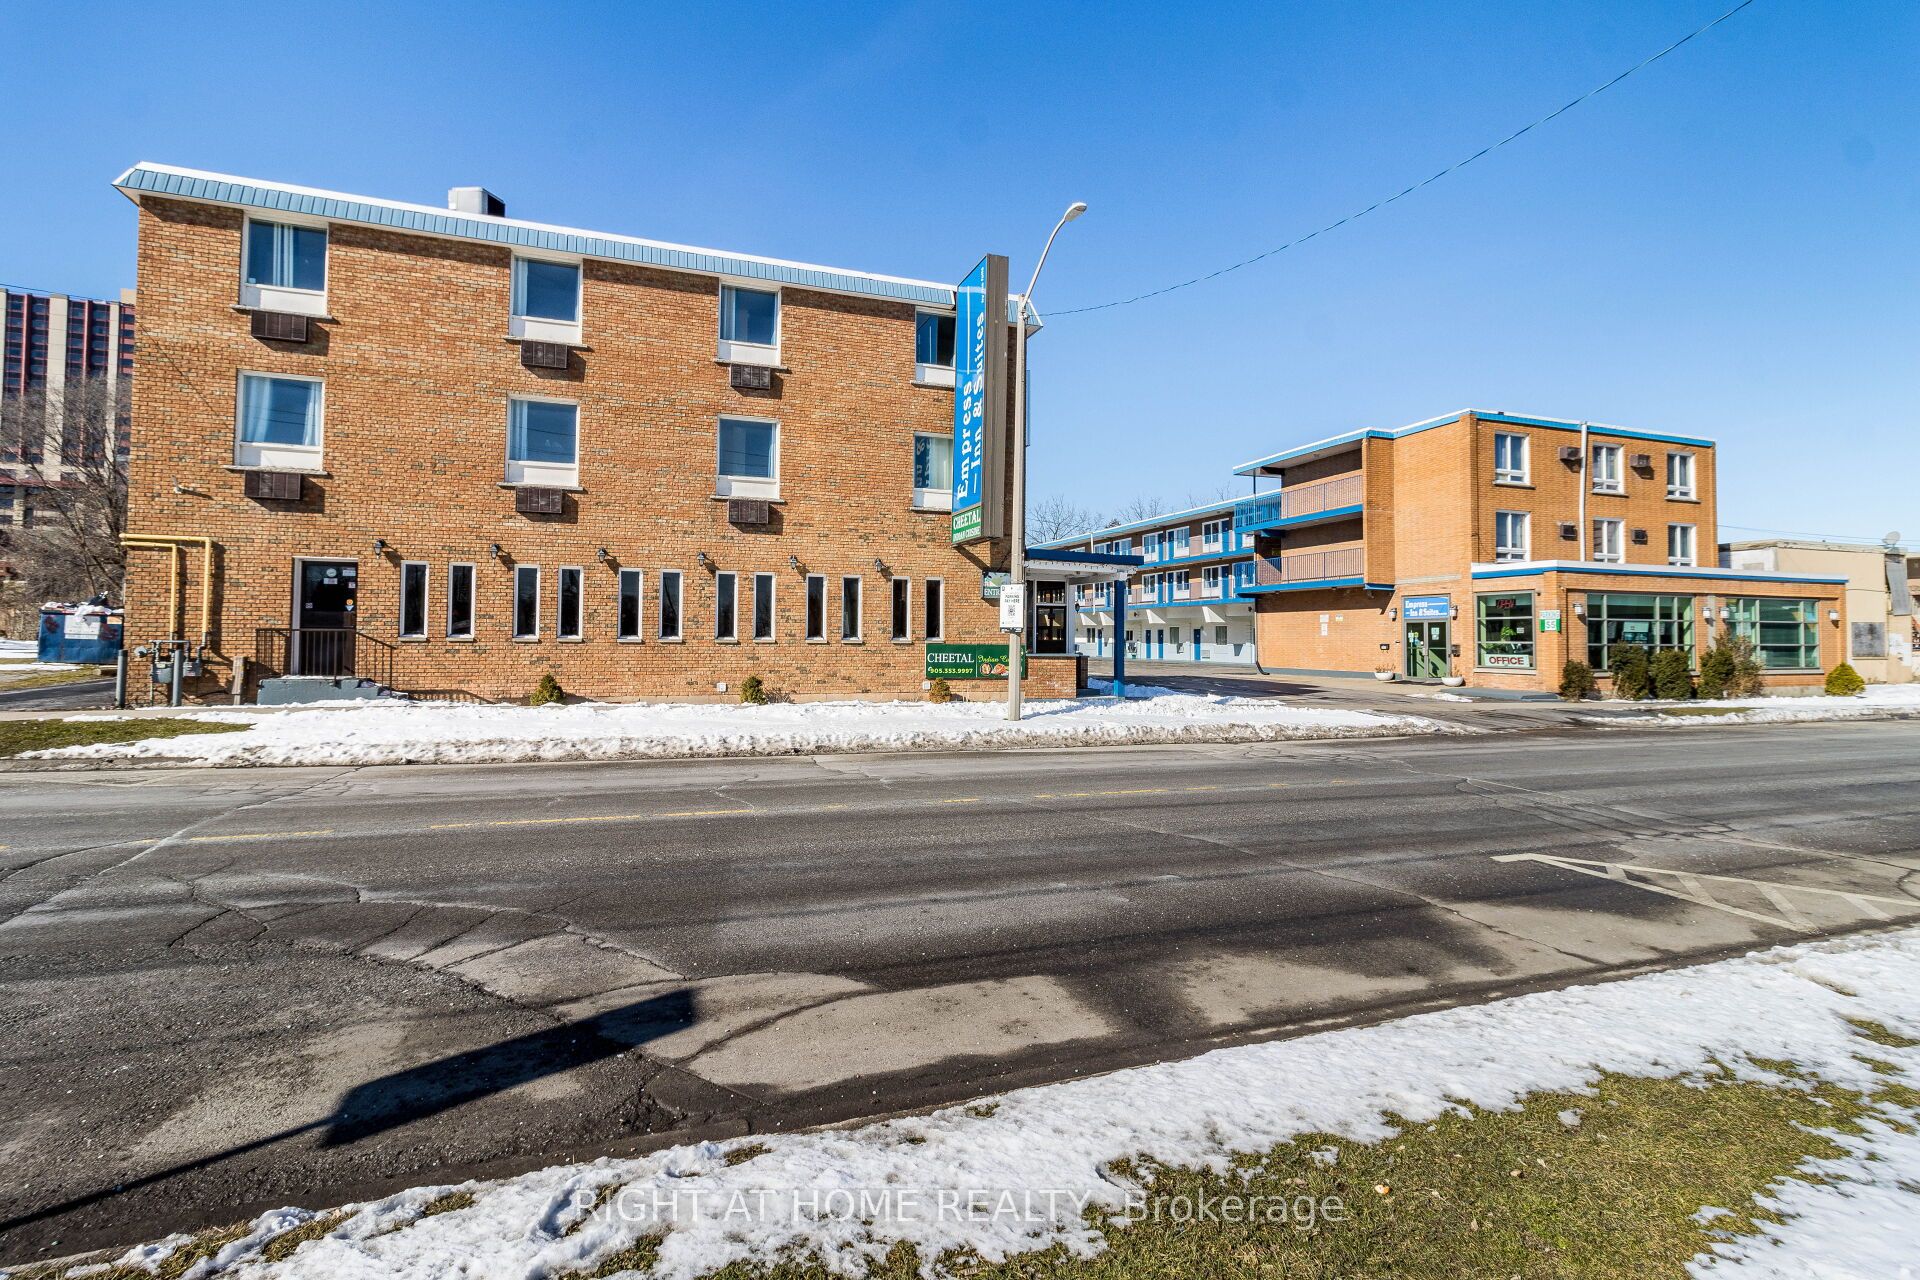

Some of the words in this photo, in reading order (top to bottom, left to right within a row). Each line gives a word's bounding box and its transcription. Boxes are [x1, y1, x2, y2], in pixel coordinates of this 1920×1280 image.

[973, 311, 984, 396] Suites
[973, 398, 982, 418] &
[956, 381, 972, 500] Empress
[971, 426, 982, 470] Inn
[953, 509, 981, 530] CHEETAL
[984, 588, 1001, 596] ENTR
[927, 653, 974, 663] CHEETAL
[1489, 656, 1524, 665] OFFICE
